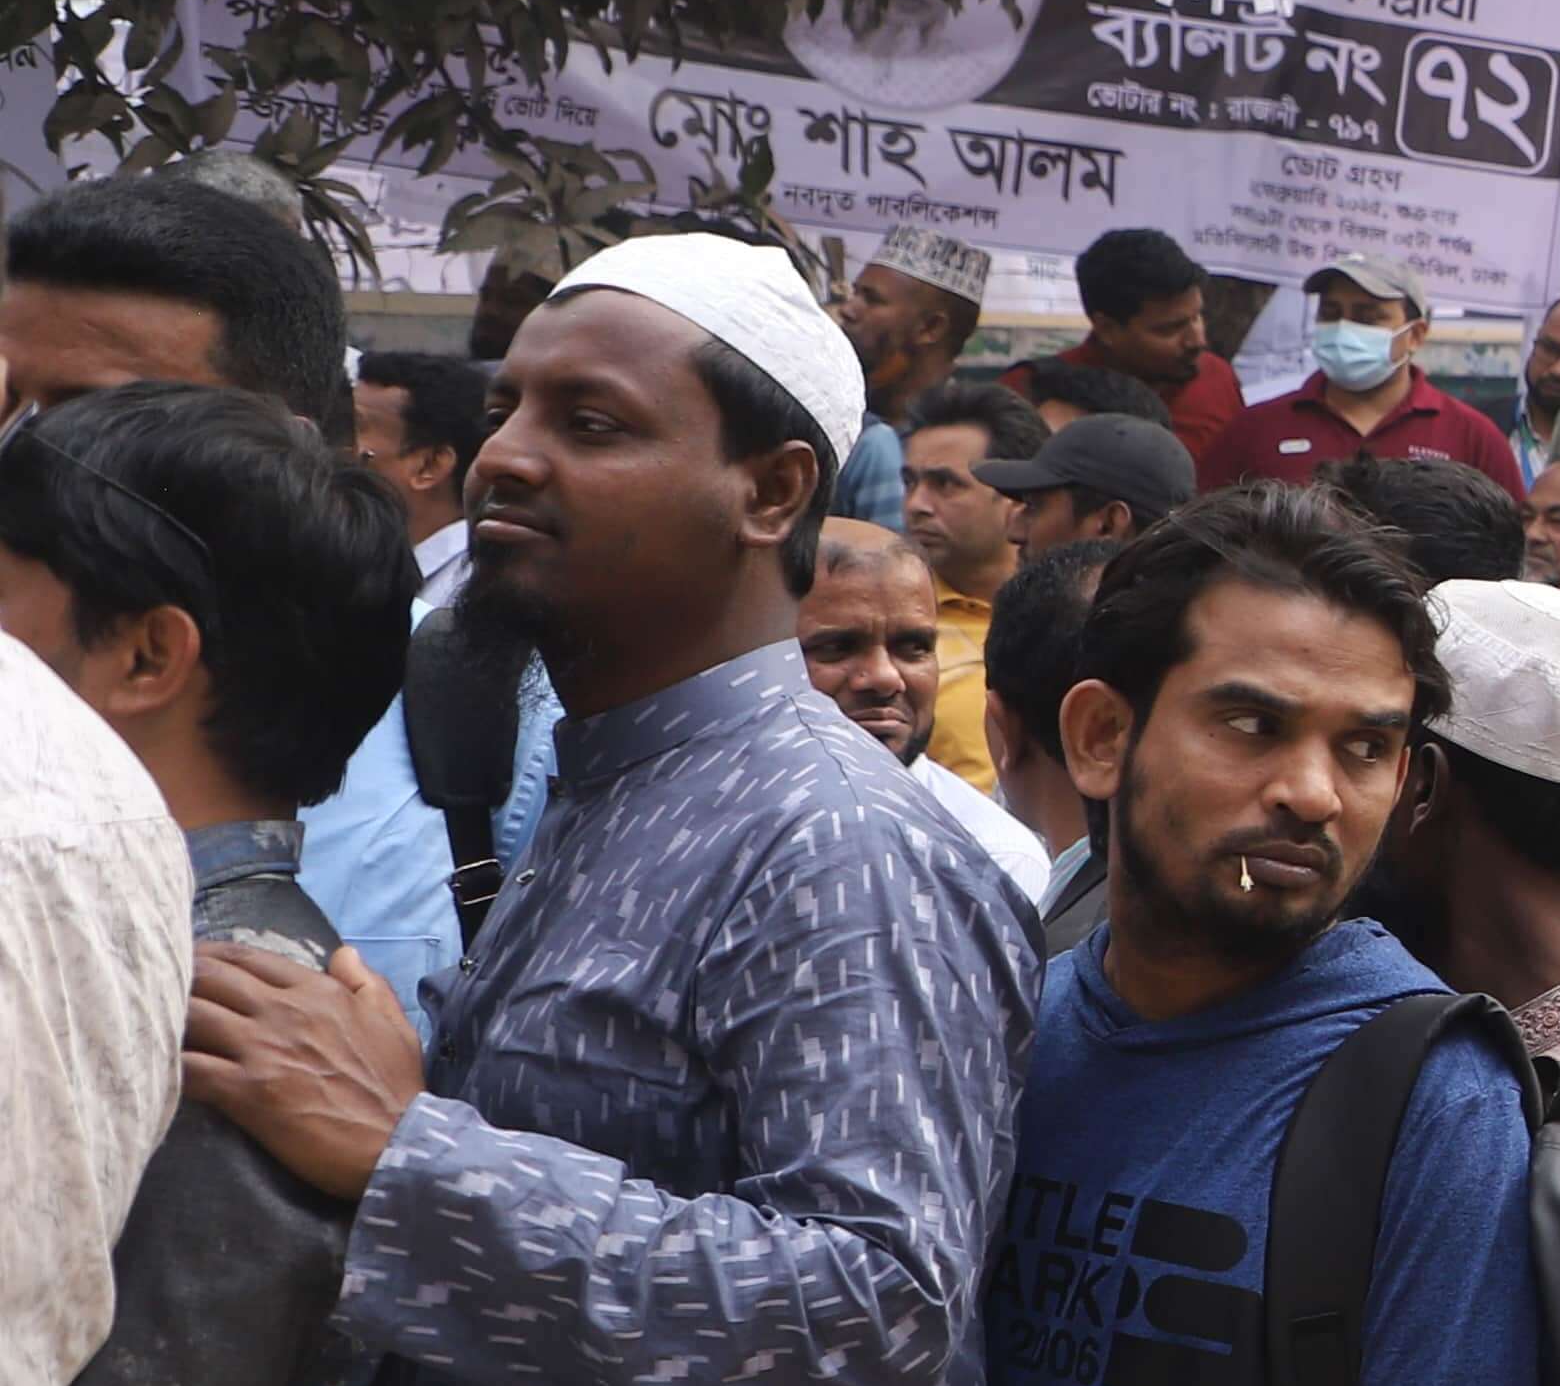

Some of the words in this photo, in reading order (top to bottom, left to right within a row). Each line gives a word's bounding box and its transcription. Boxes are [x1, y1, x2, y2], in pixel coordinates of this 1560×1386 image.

[1087, 78, 1162, 115] ভোটার
[1168, 91, 1200, 123] নং
[1328, 115, 1380, 145] ৭৯৭
[1089, 2, 1297, 77] ব্যালট
[1304, 31, 1386, 106] নং
[1415, 45, 1537, 165] ৭২
[651, 88, 772, 159] মোঃ
[801, 105, 927, 187] শাহ
[947, 128, 1126, 207] আলম
[1282, 154, 1341, 181] ভোট
[1345, 163, 1403, 191] গ্রহণ
[782, 182, 856, 217] নবদূত
